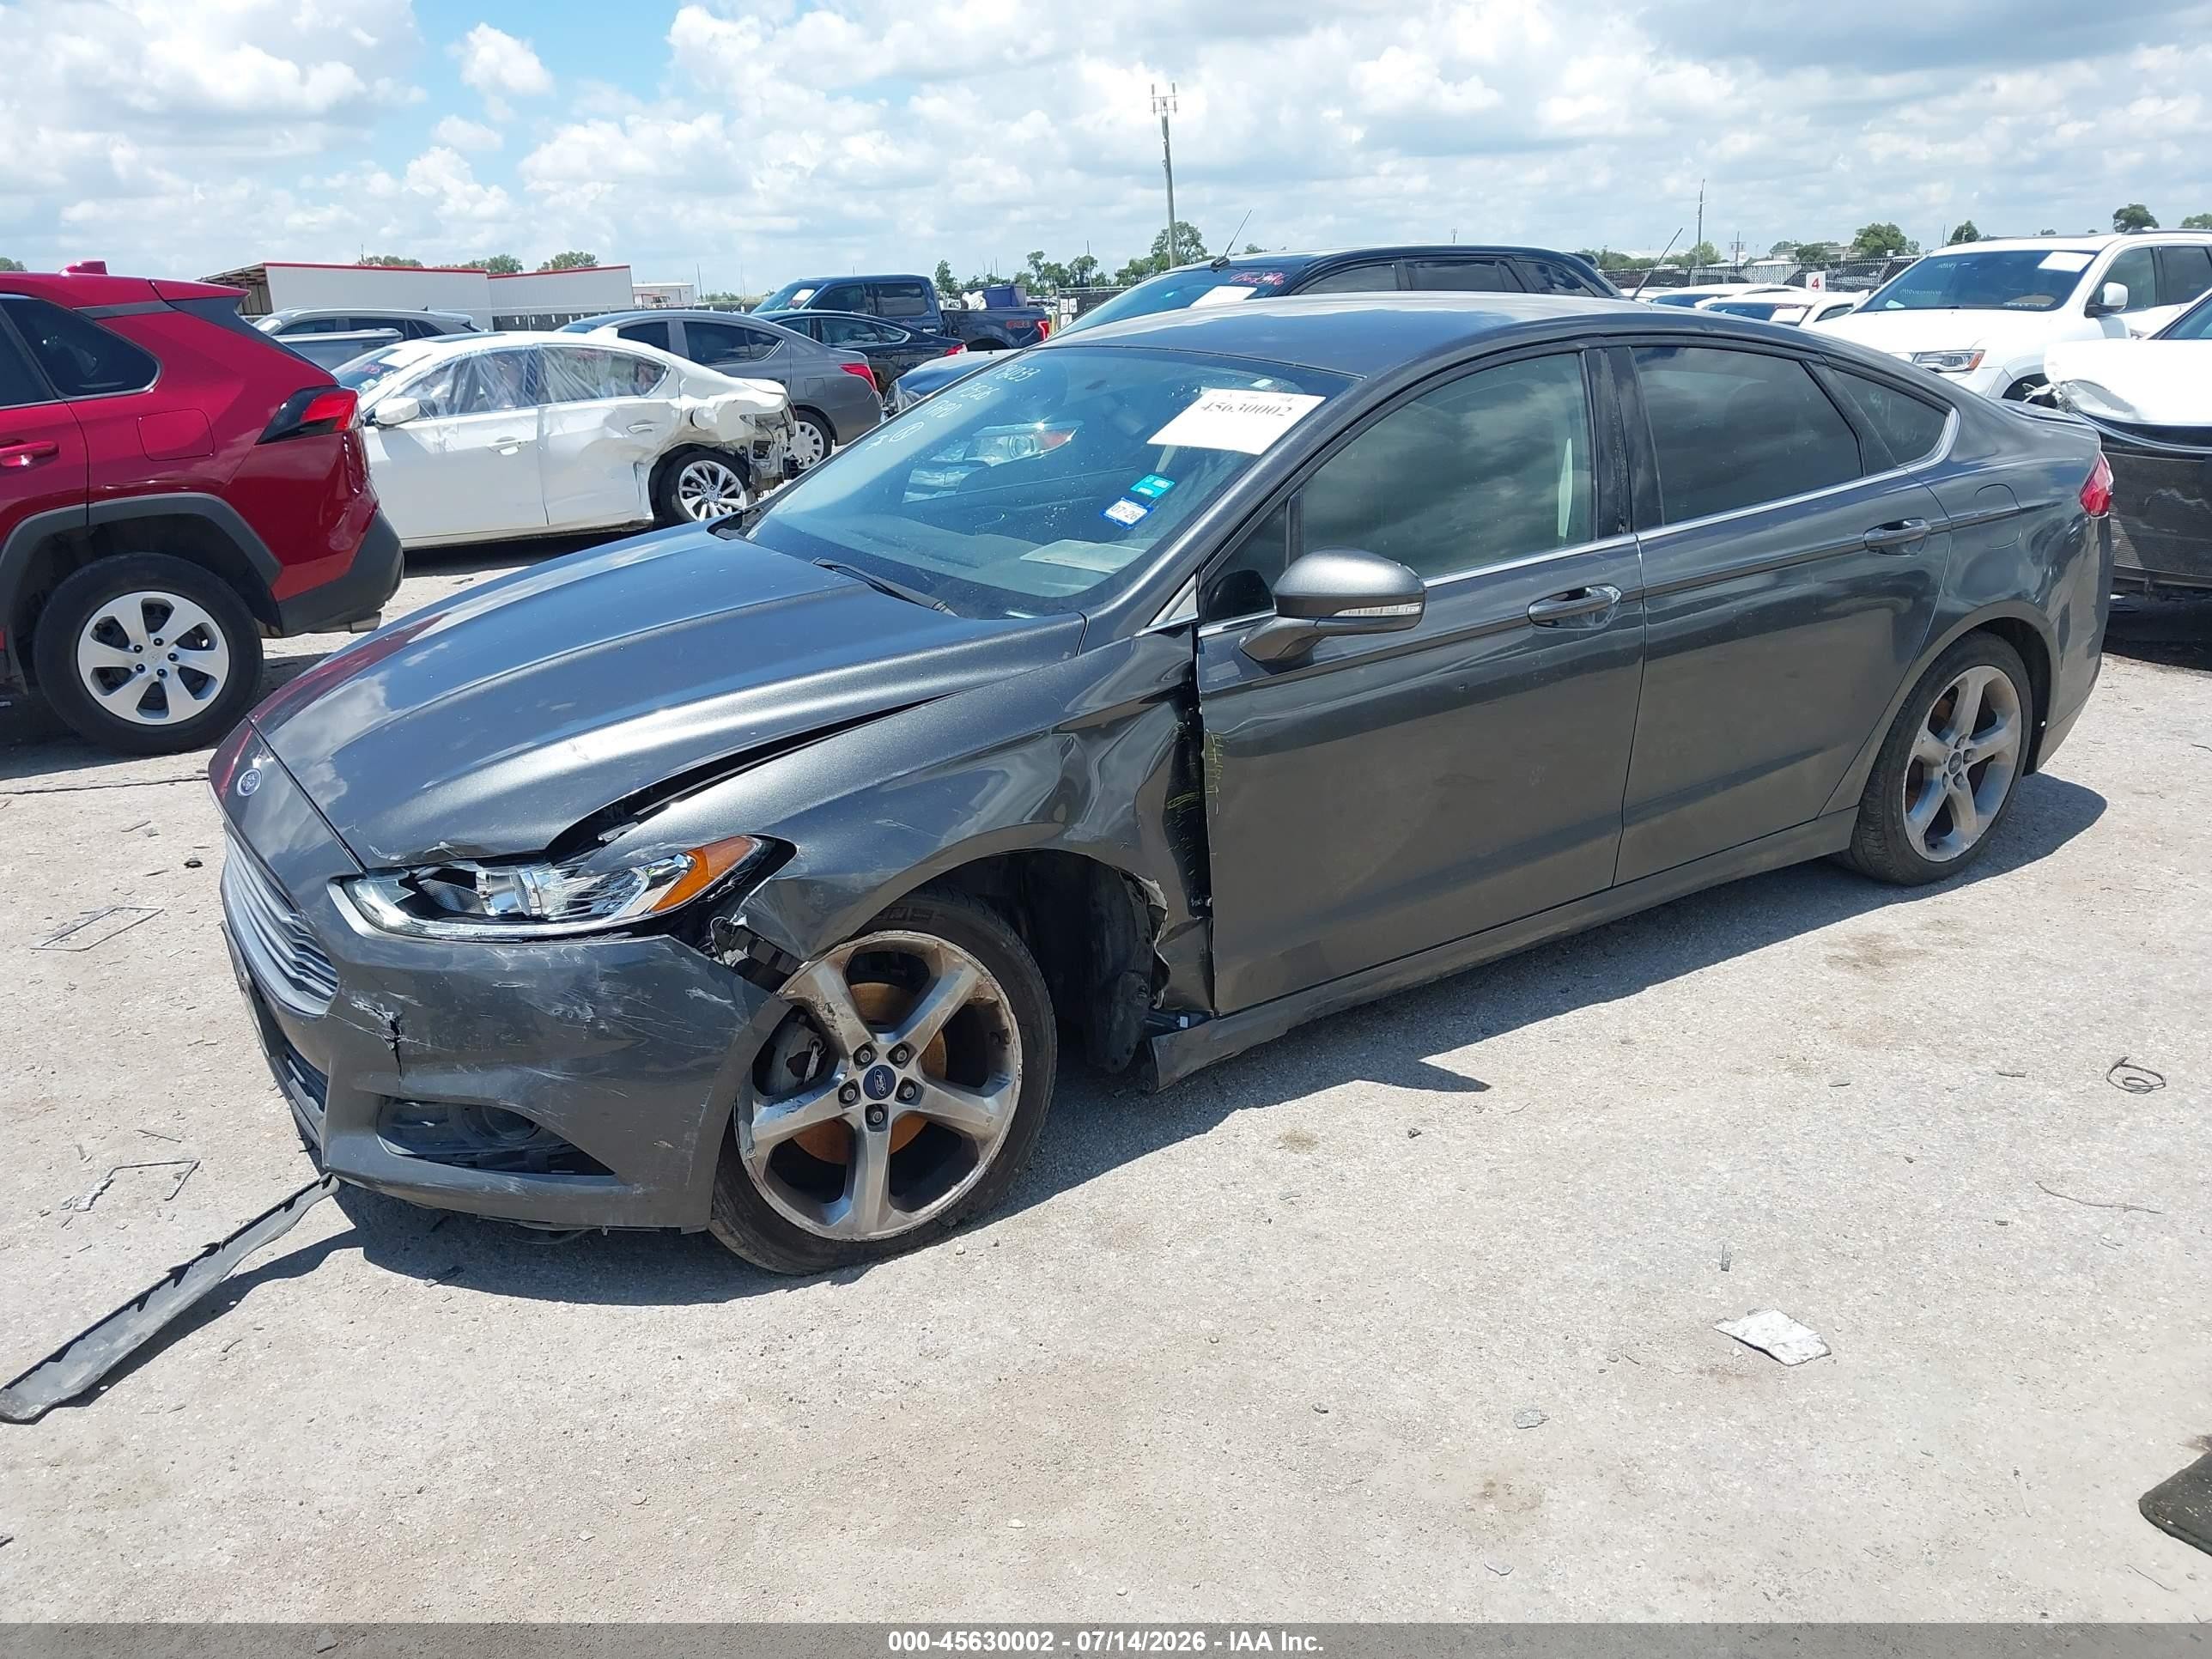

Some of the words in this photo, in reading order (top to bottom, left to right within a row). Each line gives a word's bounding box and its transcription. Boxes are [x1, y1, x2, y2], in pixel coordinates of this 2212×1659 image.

[1811, 276, 1820, 289] 4
[1200, 401, 1293, 417] 45630002
[1110, 504, 1140, 520] 07-26
